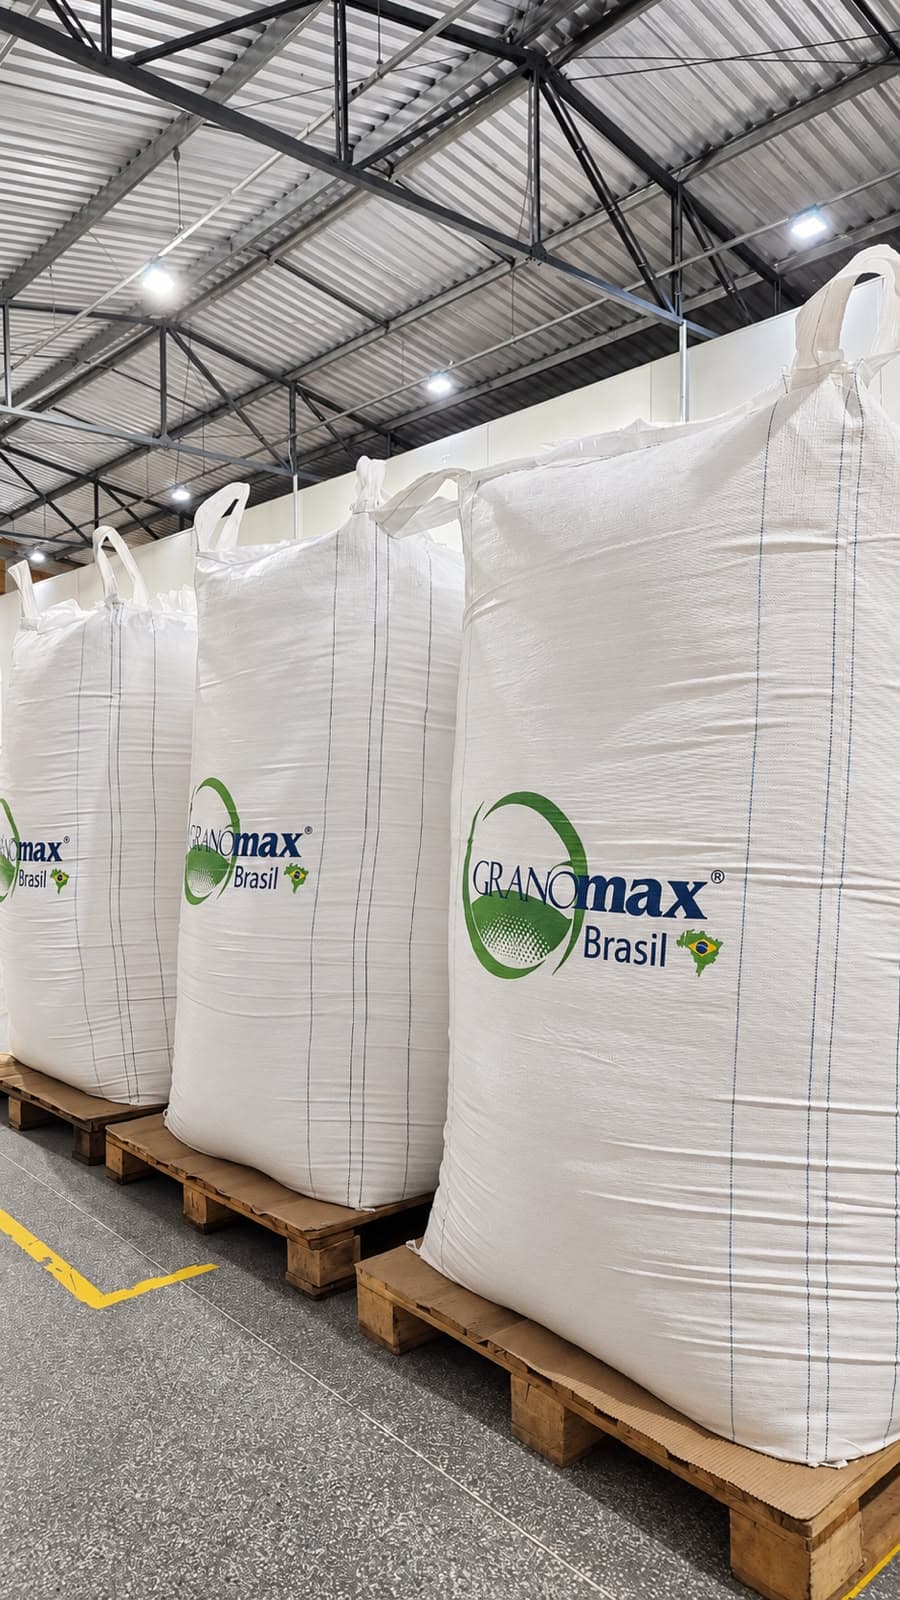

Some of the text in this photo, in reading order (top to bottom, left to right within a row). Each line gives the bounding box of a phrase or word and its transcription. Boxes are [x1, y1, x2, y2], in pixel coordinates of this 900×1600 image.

[19, 869, 47, 888] Brasil
[234, 866, 279, 890] Brasil
[584, 925, 668, 967] Brasil
